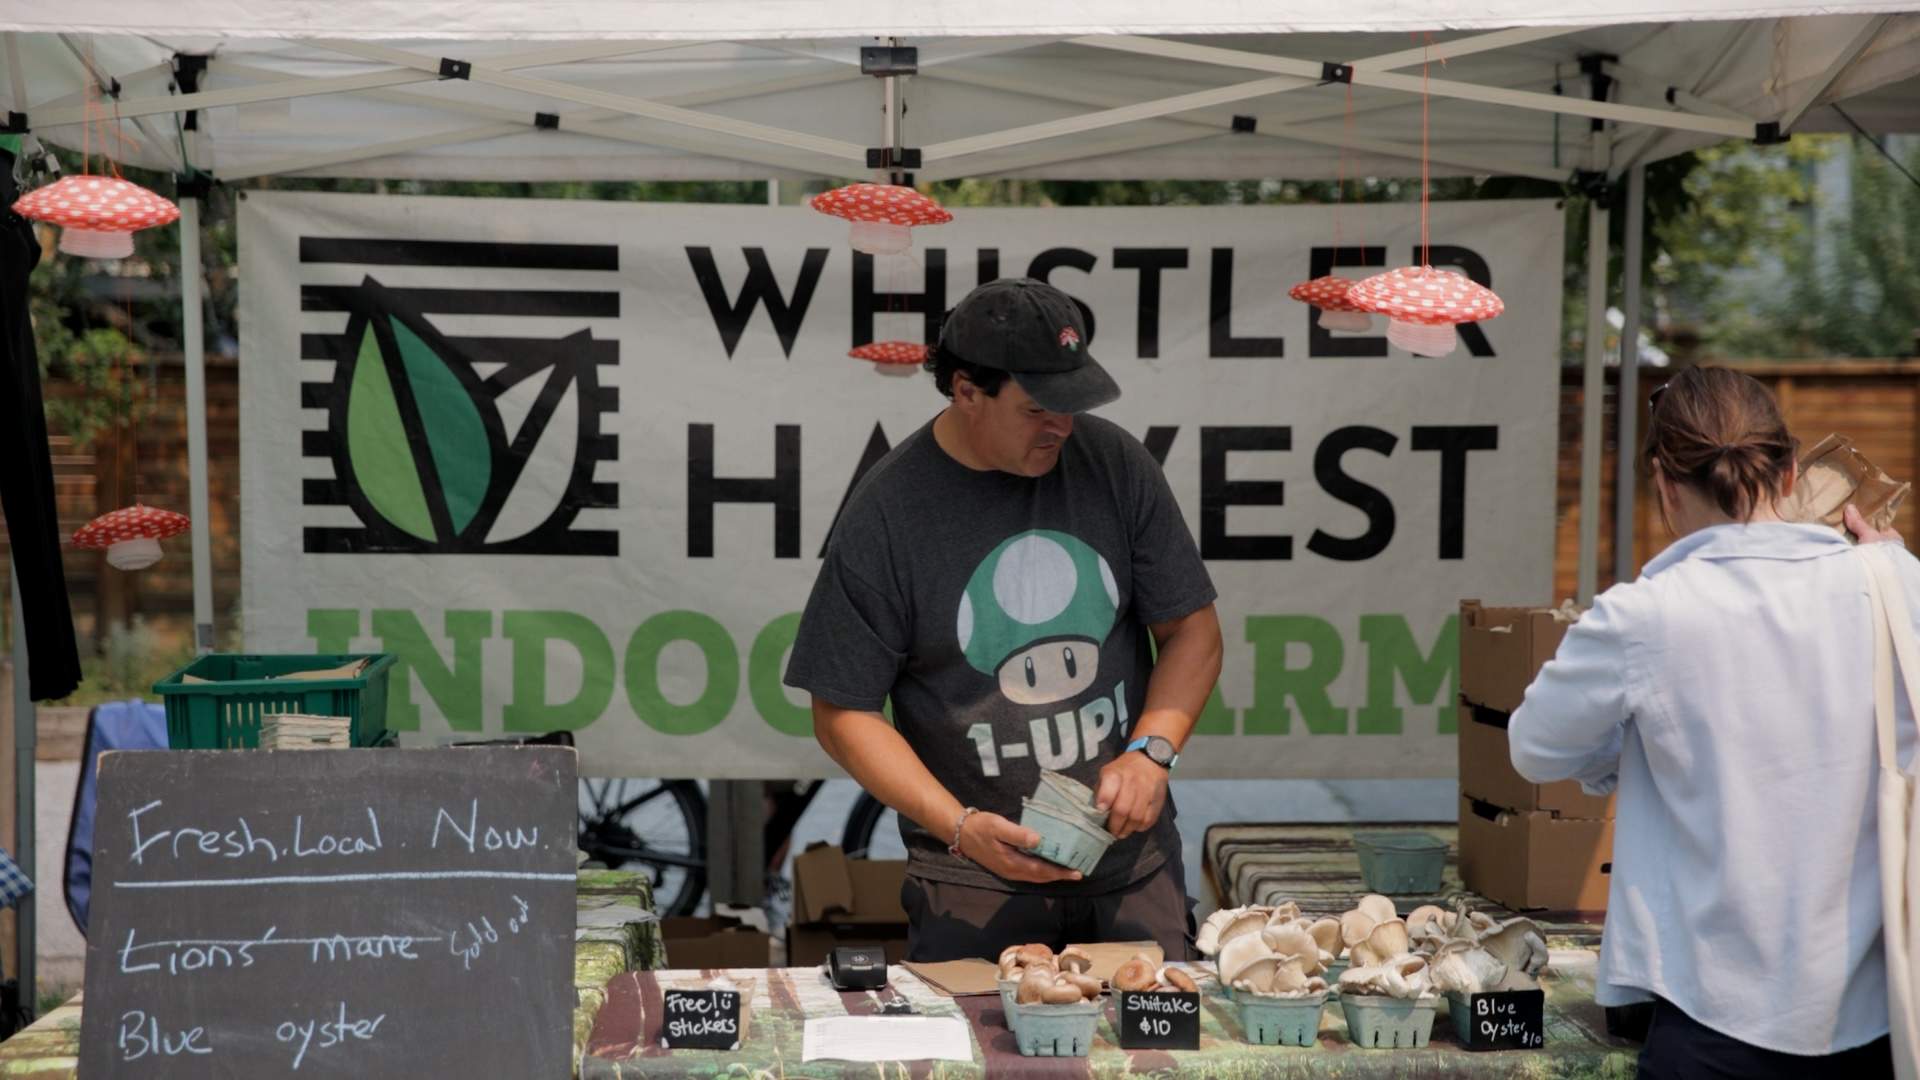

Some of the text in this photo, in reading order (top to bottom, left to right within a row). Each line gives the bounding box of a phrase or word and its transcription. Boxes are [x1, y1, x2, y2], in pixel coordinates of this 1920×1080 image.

[687, 421, 1498, 561] HEST
[967, 680, 1128, 777] 1-UP!
[432, 799, 549, 852] Now.
[312, 934, 419, 963] mane
[1139, 1016, 1171, 1036] $10
[1477, 999, 1517, 1016] Blue
[119, 1001, 385, 1069] Blue oyster
[1480, 1018, 1526, 1042] Oyster
